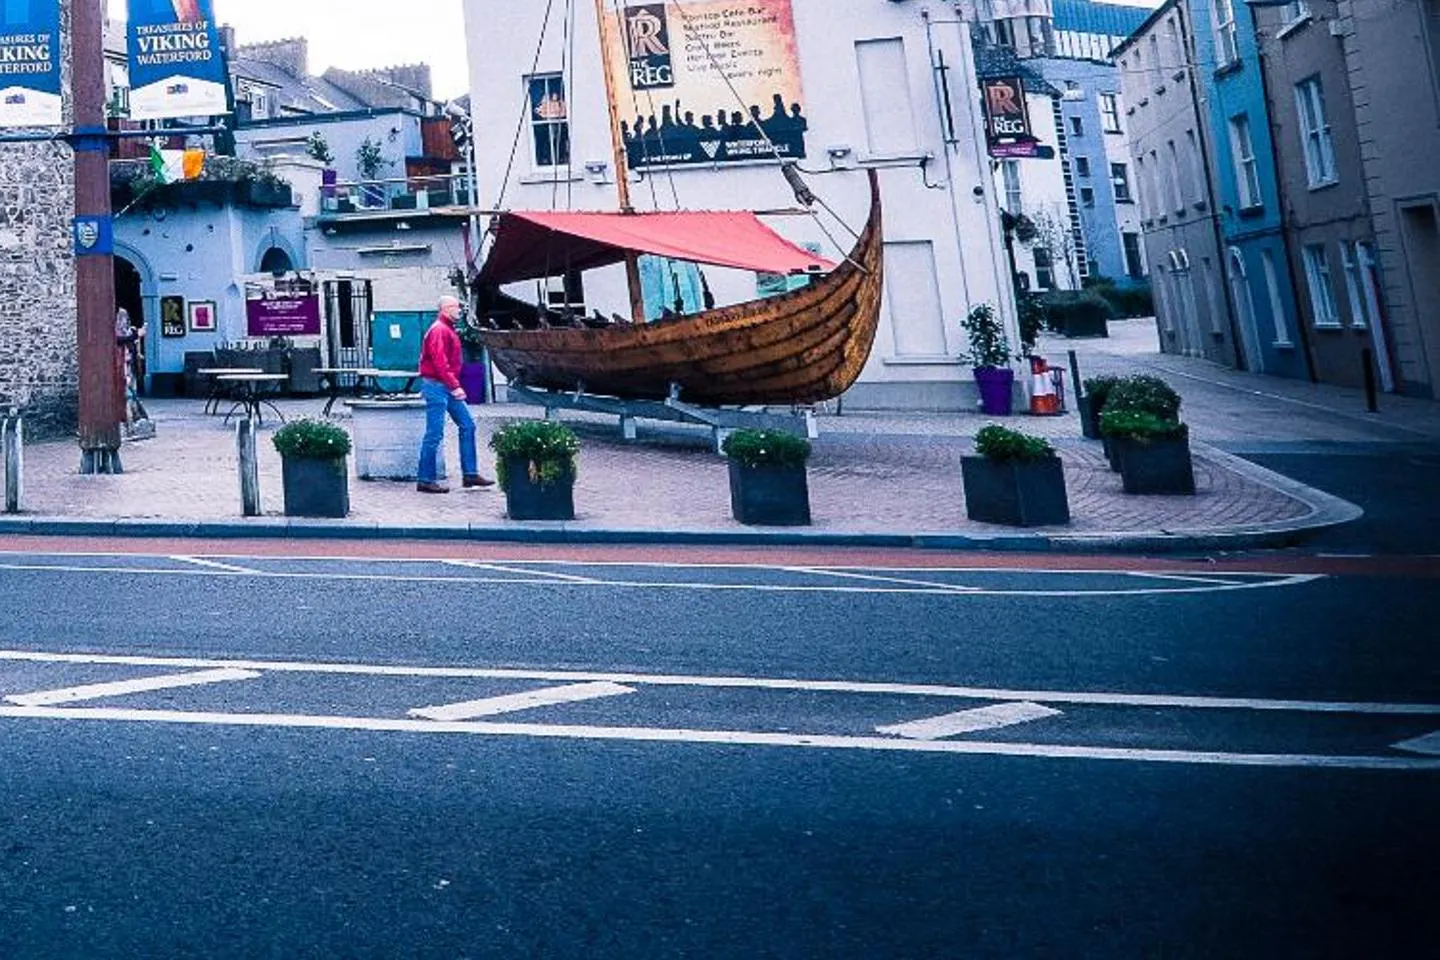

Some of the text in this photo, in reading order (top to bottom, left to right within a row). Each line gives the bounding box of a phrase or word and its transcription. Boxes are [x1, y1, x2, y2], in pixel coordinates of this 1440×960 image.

[136, 20, 209, 36] TREASURES OF
[37, 33, 51, 43] OF
[137, 32, 210, 53] VIKING
[136, 49, 213, 66] WATERFORD
[633, 65, 673, 86] REG
[993, 120, 1025, 136] REG
